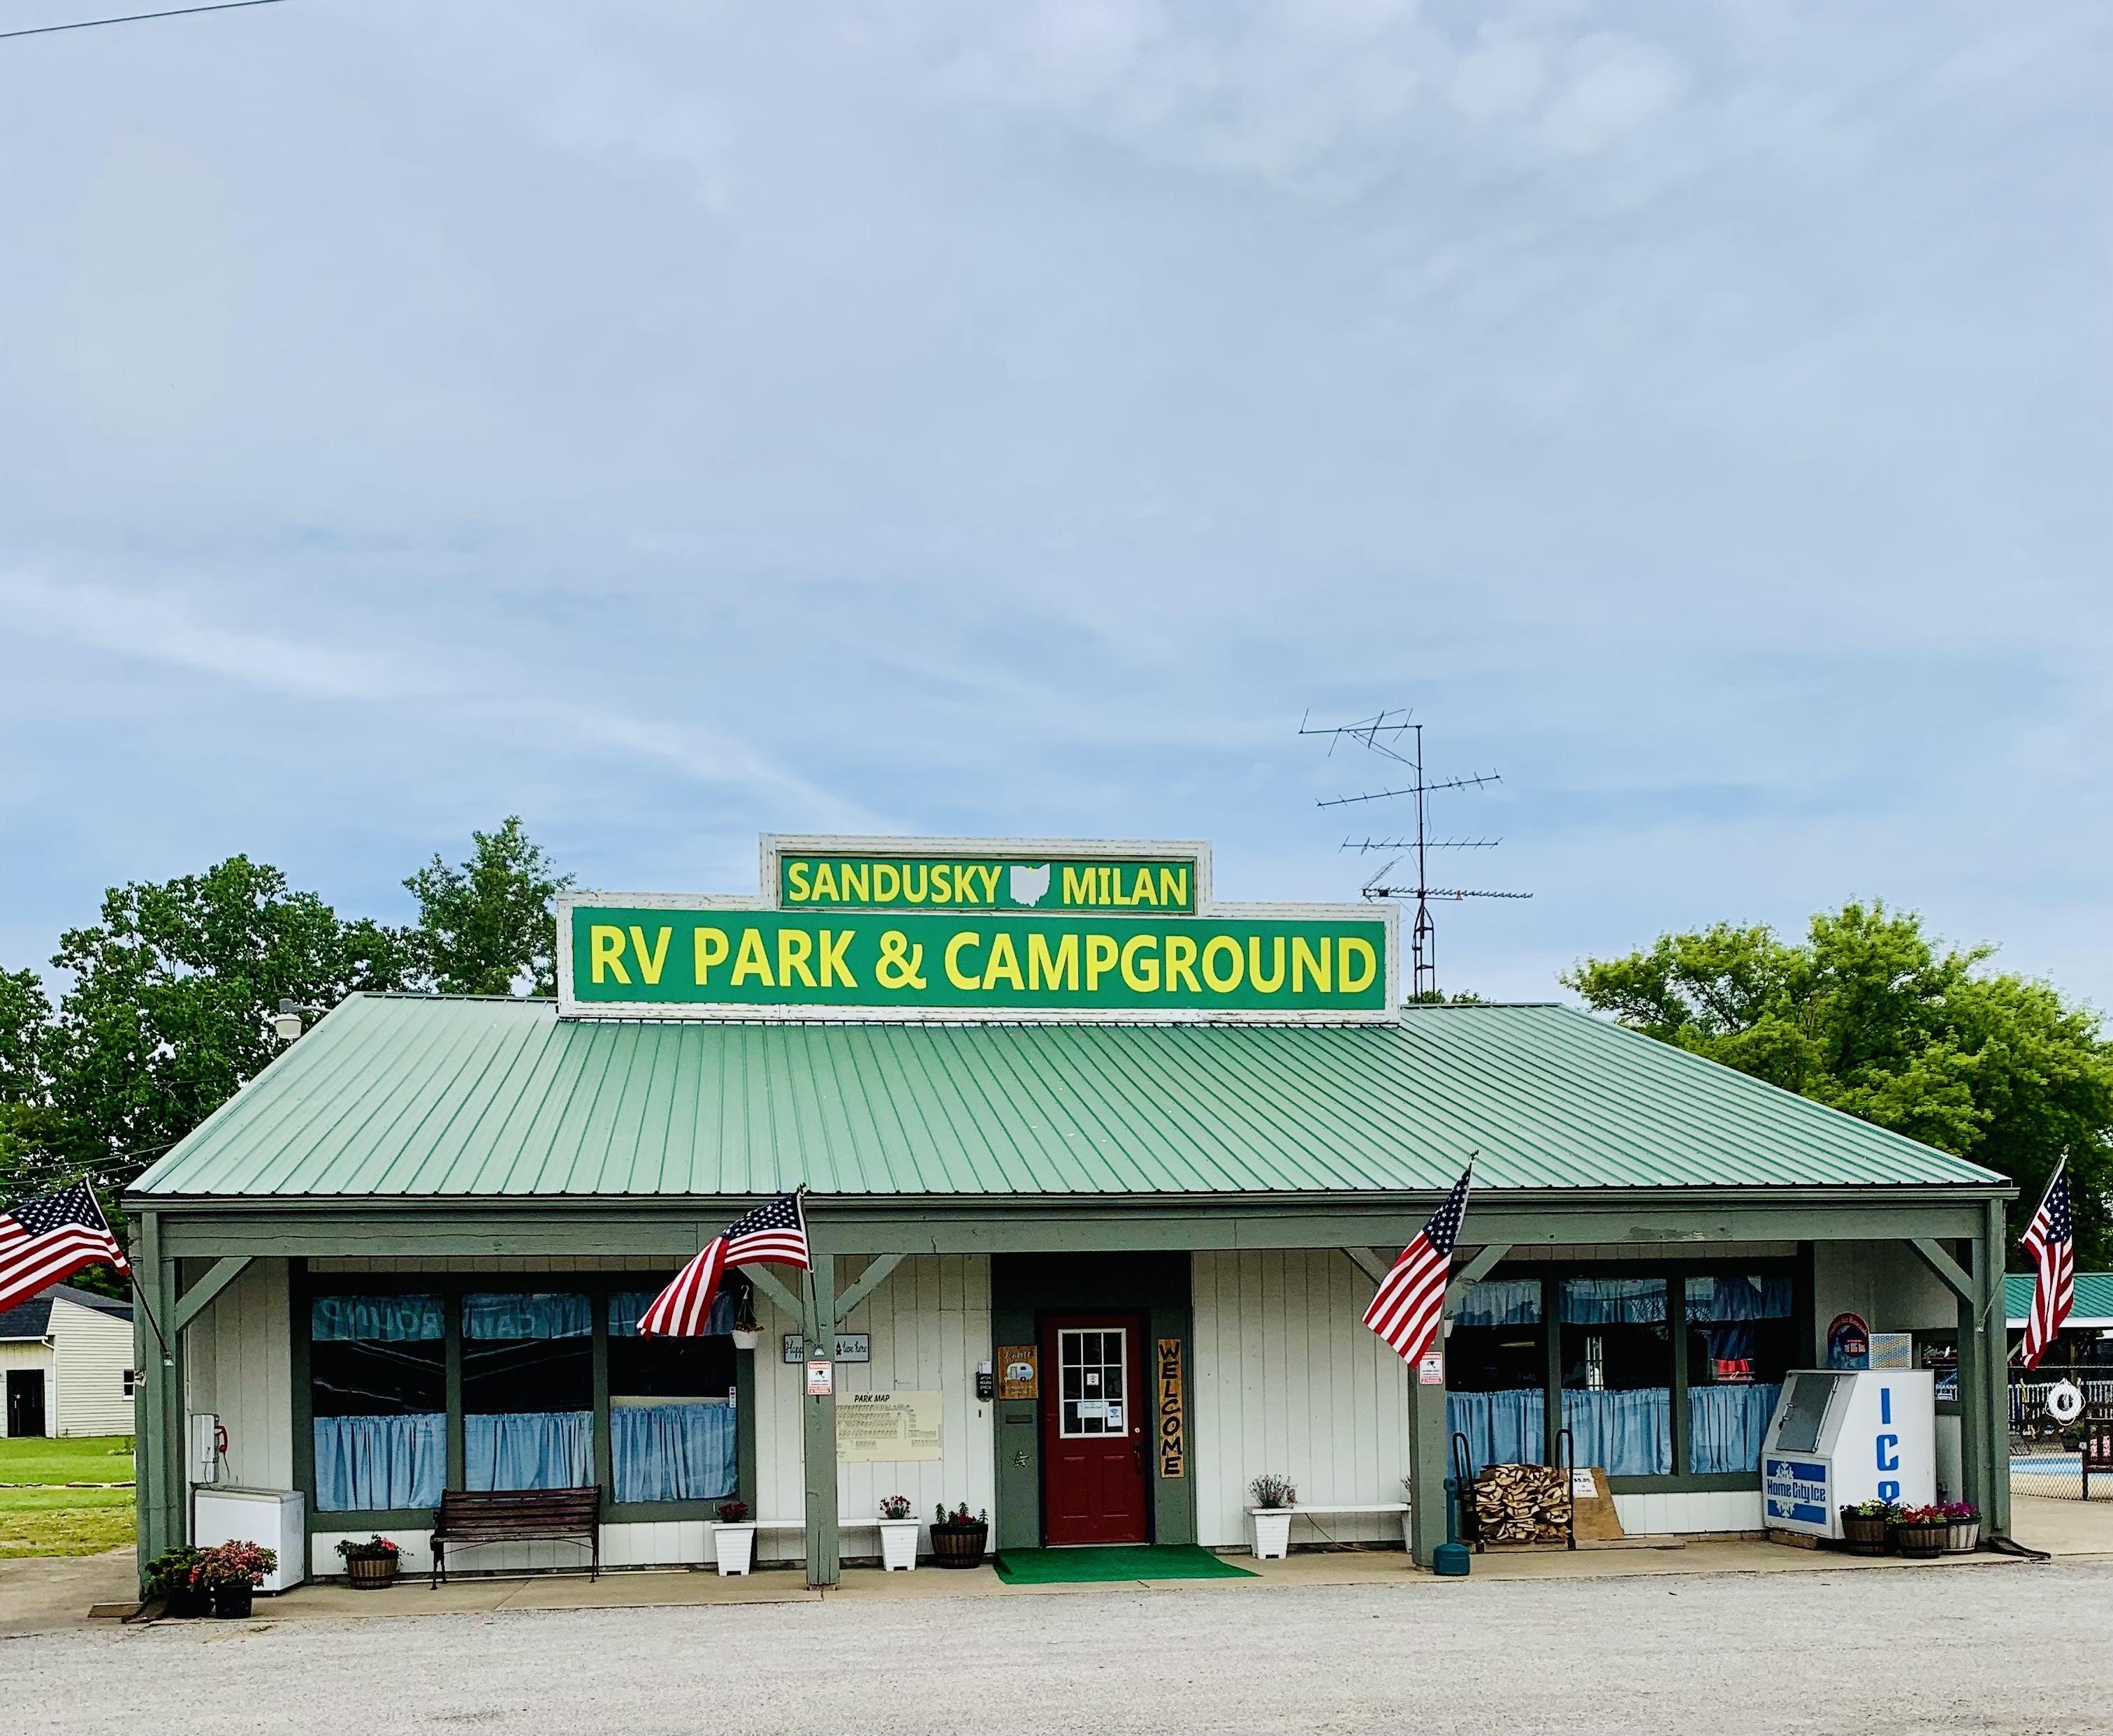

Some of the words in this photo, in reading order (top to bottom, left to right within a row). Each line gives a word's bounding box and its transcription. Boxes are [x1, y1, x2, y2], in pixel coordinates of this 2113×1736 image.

[789, 862, 1002, 903] SANDUSKY
[1062, 866, 1186, 905] MILAN
[590, 925, 673, 984] RV
[694, 927, 859, 988] PARK
[876, 931, 927, 989] &
[945, 932, 1377, 993] CAMPGROUND
[854, 1340, 867, 1353] here
[854, 1394, 873, 1403] PARK
[873, 1394, 890, 1403] MAP
[1159, 1341, 1183, 1475] WELCOME
[1767, 1478, 1792, 1497] Home
[1792, 1482, 1810, 1503] City
[1810, 1484, 1826, 1502] Ice
